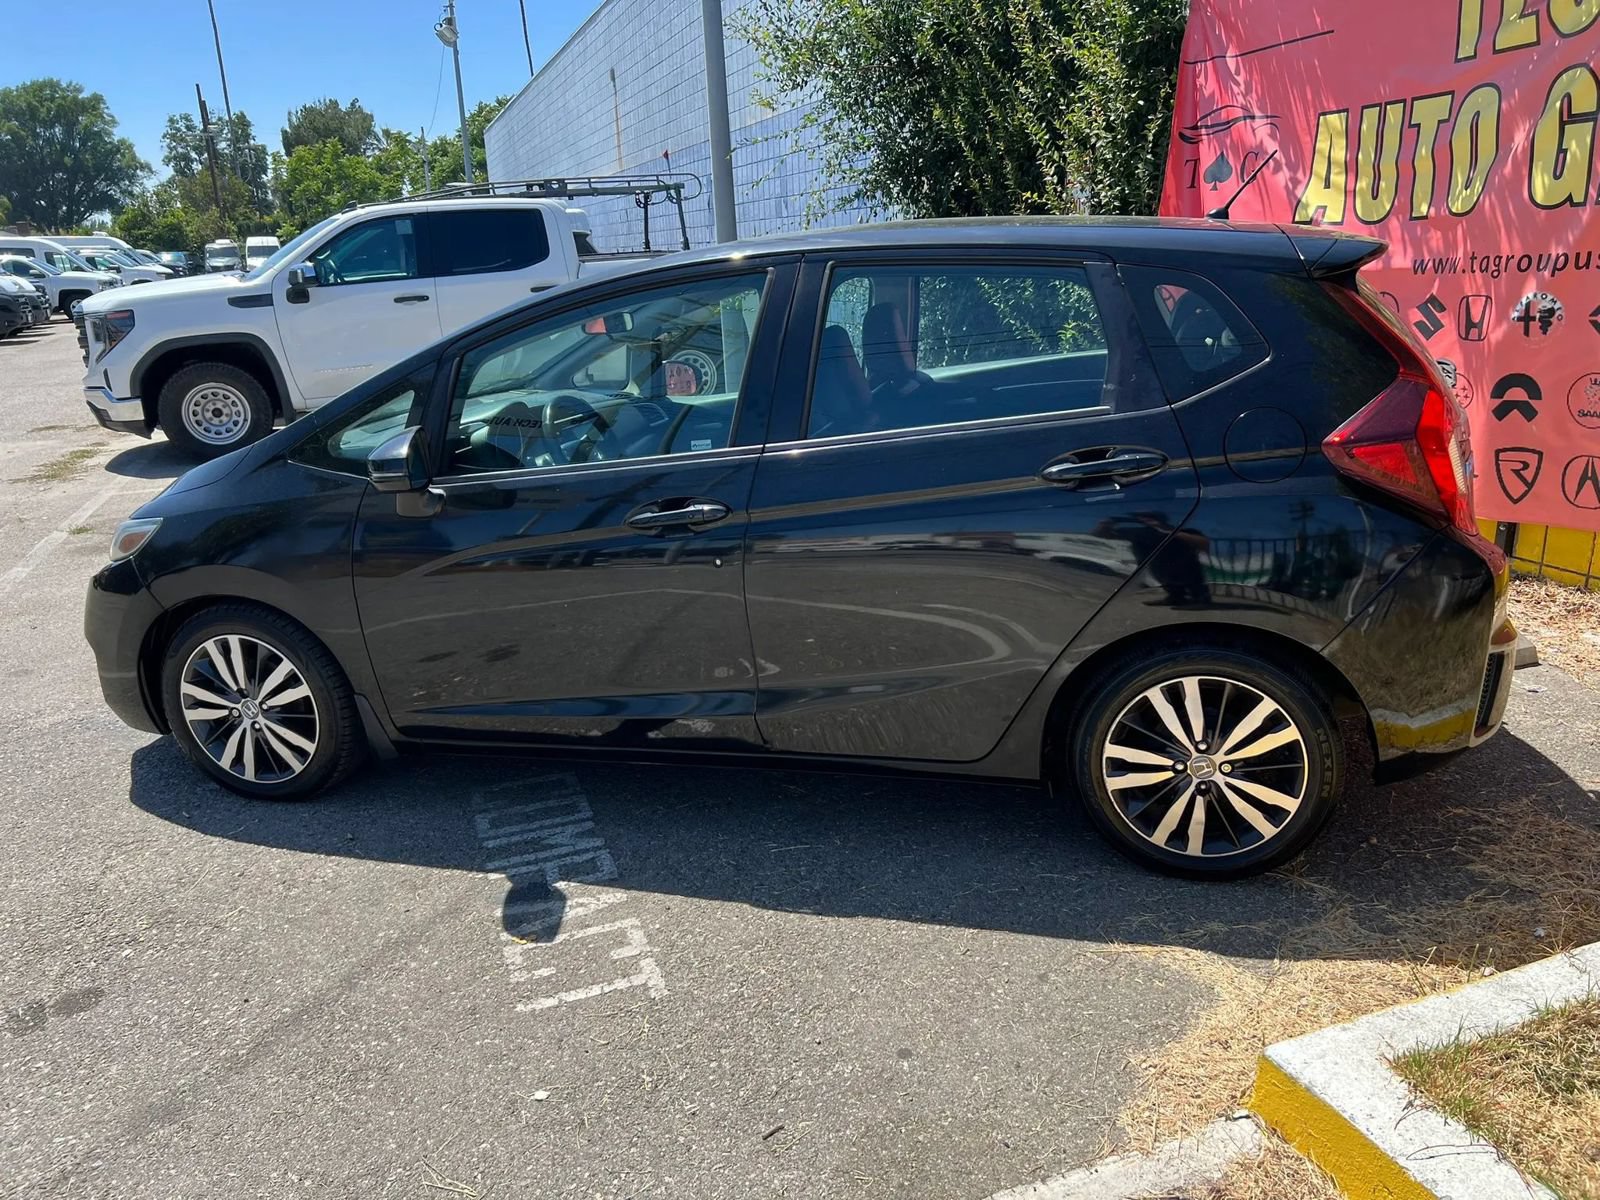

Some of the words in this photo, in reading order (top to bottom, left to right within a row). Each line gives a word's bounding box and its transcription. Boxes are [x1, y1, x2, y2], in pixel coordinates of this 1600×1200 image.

[1294, 82, 1501, 225] AUTO
[1577, 409, 1600, 419] SAA
[1316, 728, 1333, 798] NEXEN
